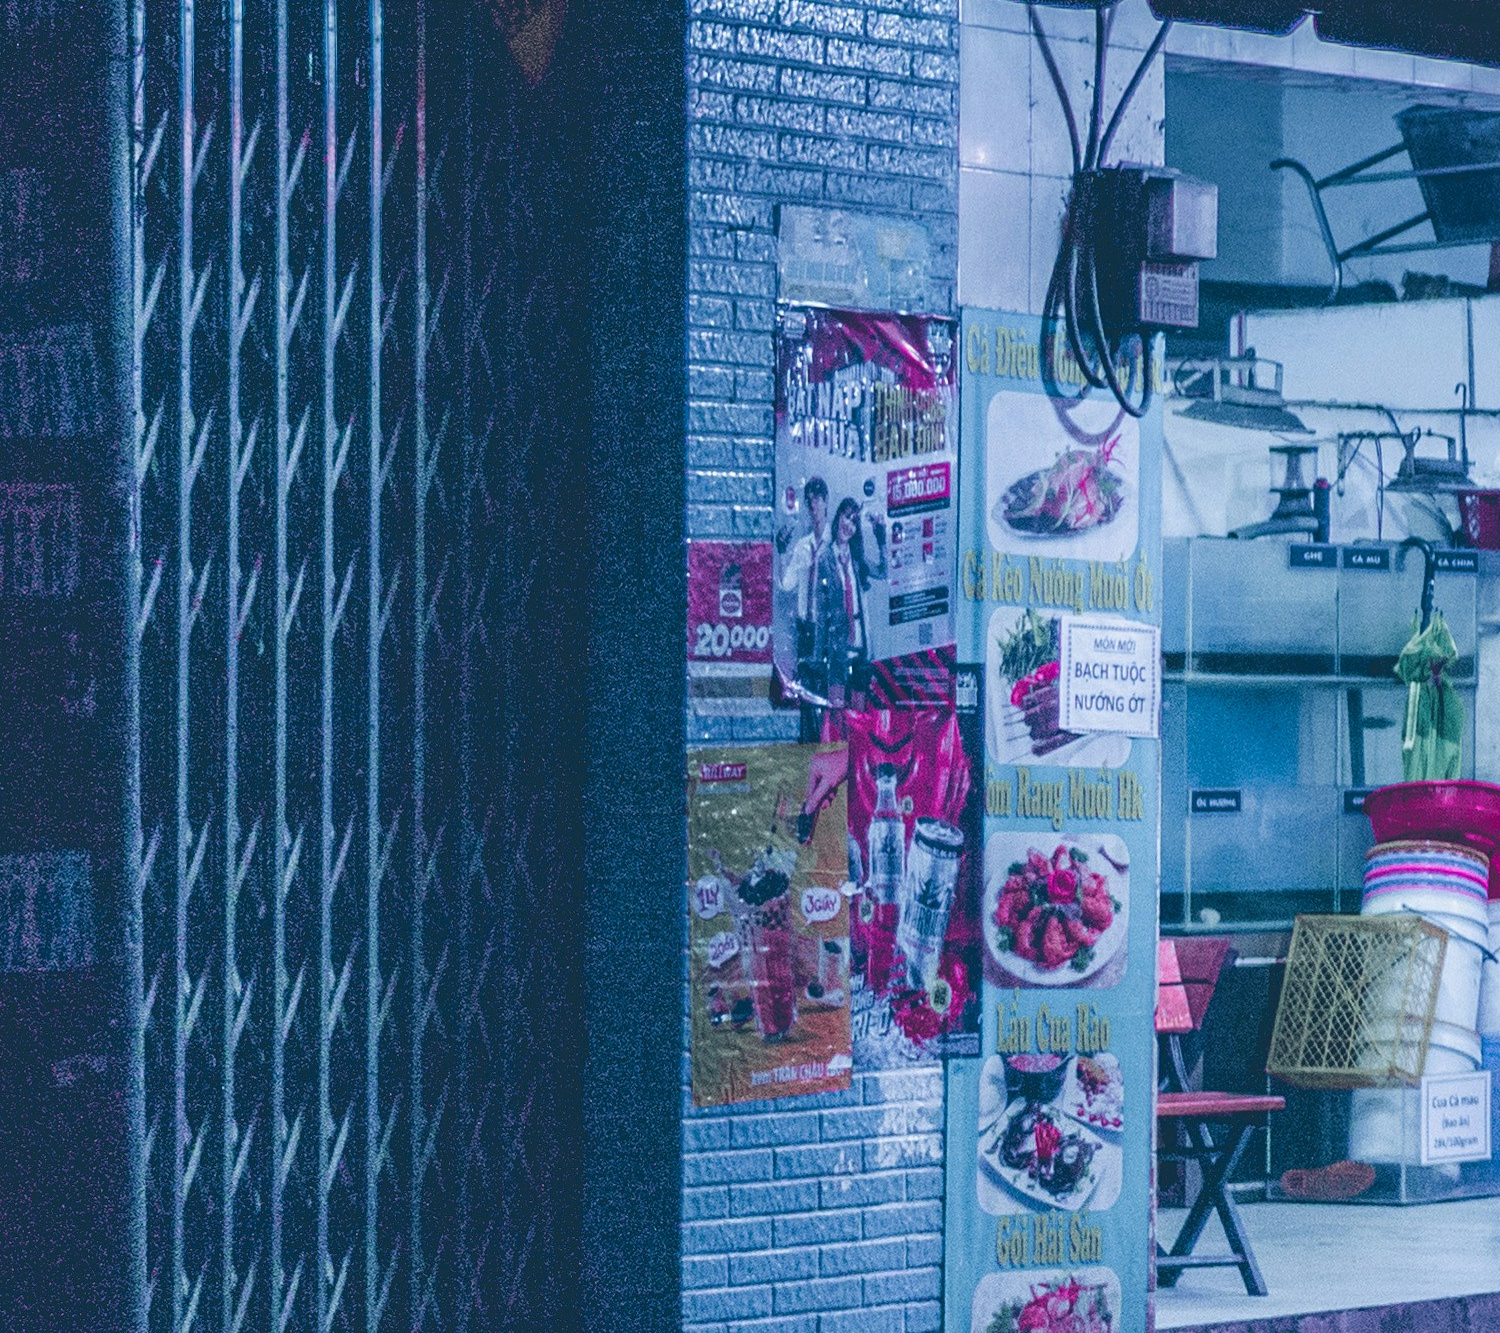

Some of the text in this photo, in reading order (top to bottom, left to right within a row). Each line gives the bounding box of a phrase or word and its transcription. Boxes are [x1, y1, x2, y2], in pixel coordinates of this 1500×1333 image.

[992, 551, 1023, 602] Kèo
[1093, 635, 1136, 653] MÓN MỚI
[1073, 660, 1147, 685] BẠCH TUỘC
[1073, 690, 1147, 714] NƯỚNG ỚT
[985, 765, 1011, 817] ôm
[1016, 766, 1064, 830] Rang
[1068, 761, 1112, 819] Muối
[1036, 1003, 1070, 1053] Cua
[1432, 1096, 1447, 1109] Cua
[1032, 1208, 1063, 1265] Hải
[1069, 1208, 1103, 1264] Sản
